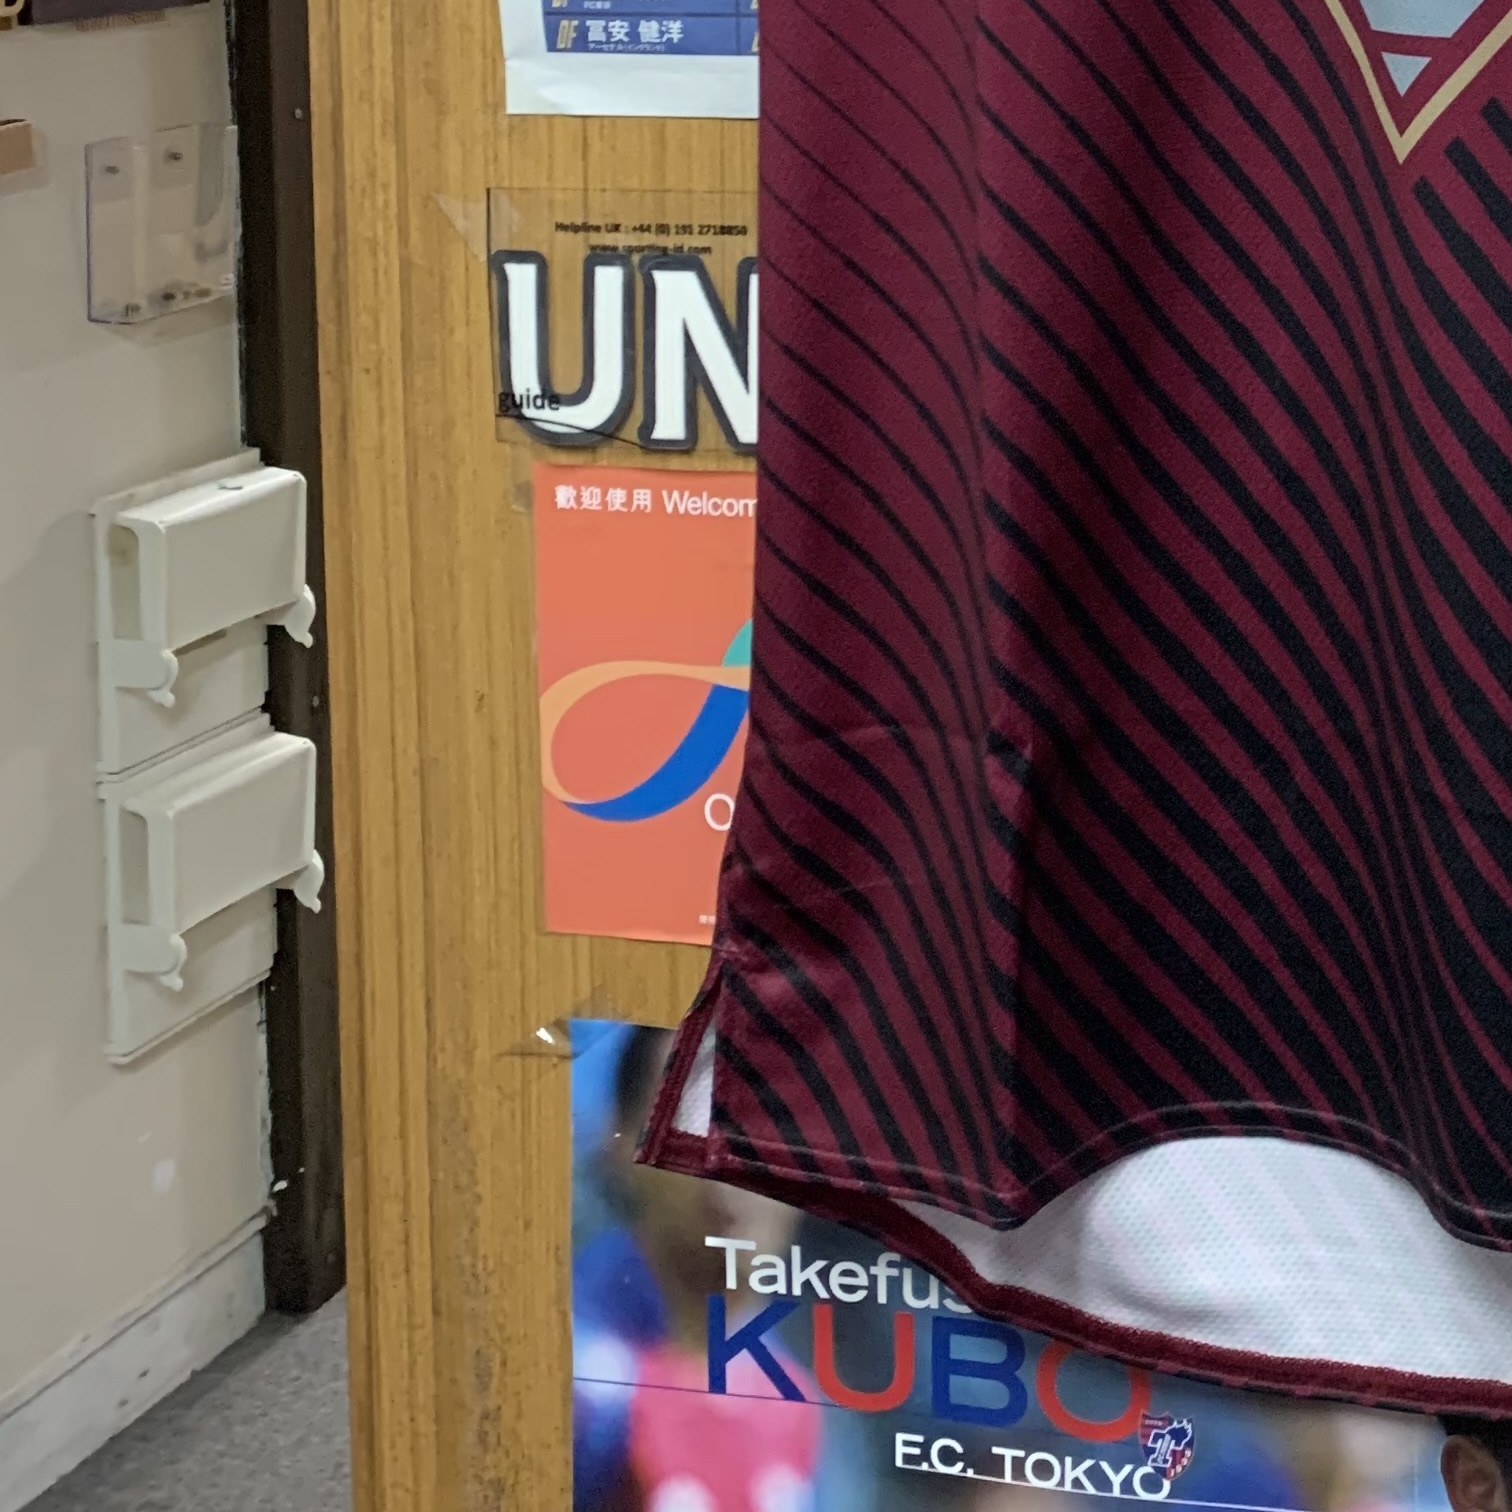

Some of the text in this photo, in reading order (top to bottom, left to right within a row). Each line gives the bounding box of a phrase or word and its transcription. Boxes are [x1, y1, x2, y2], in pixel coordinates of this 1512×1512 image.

[555, 221, 602, 235] Helpline
[492, 249, 759, 455] UN
[499, 388, 560, 413] guide
[707, 1292, 1151, 1444] KUBO
[991, 1446, 1172, 1501] TOKYO
